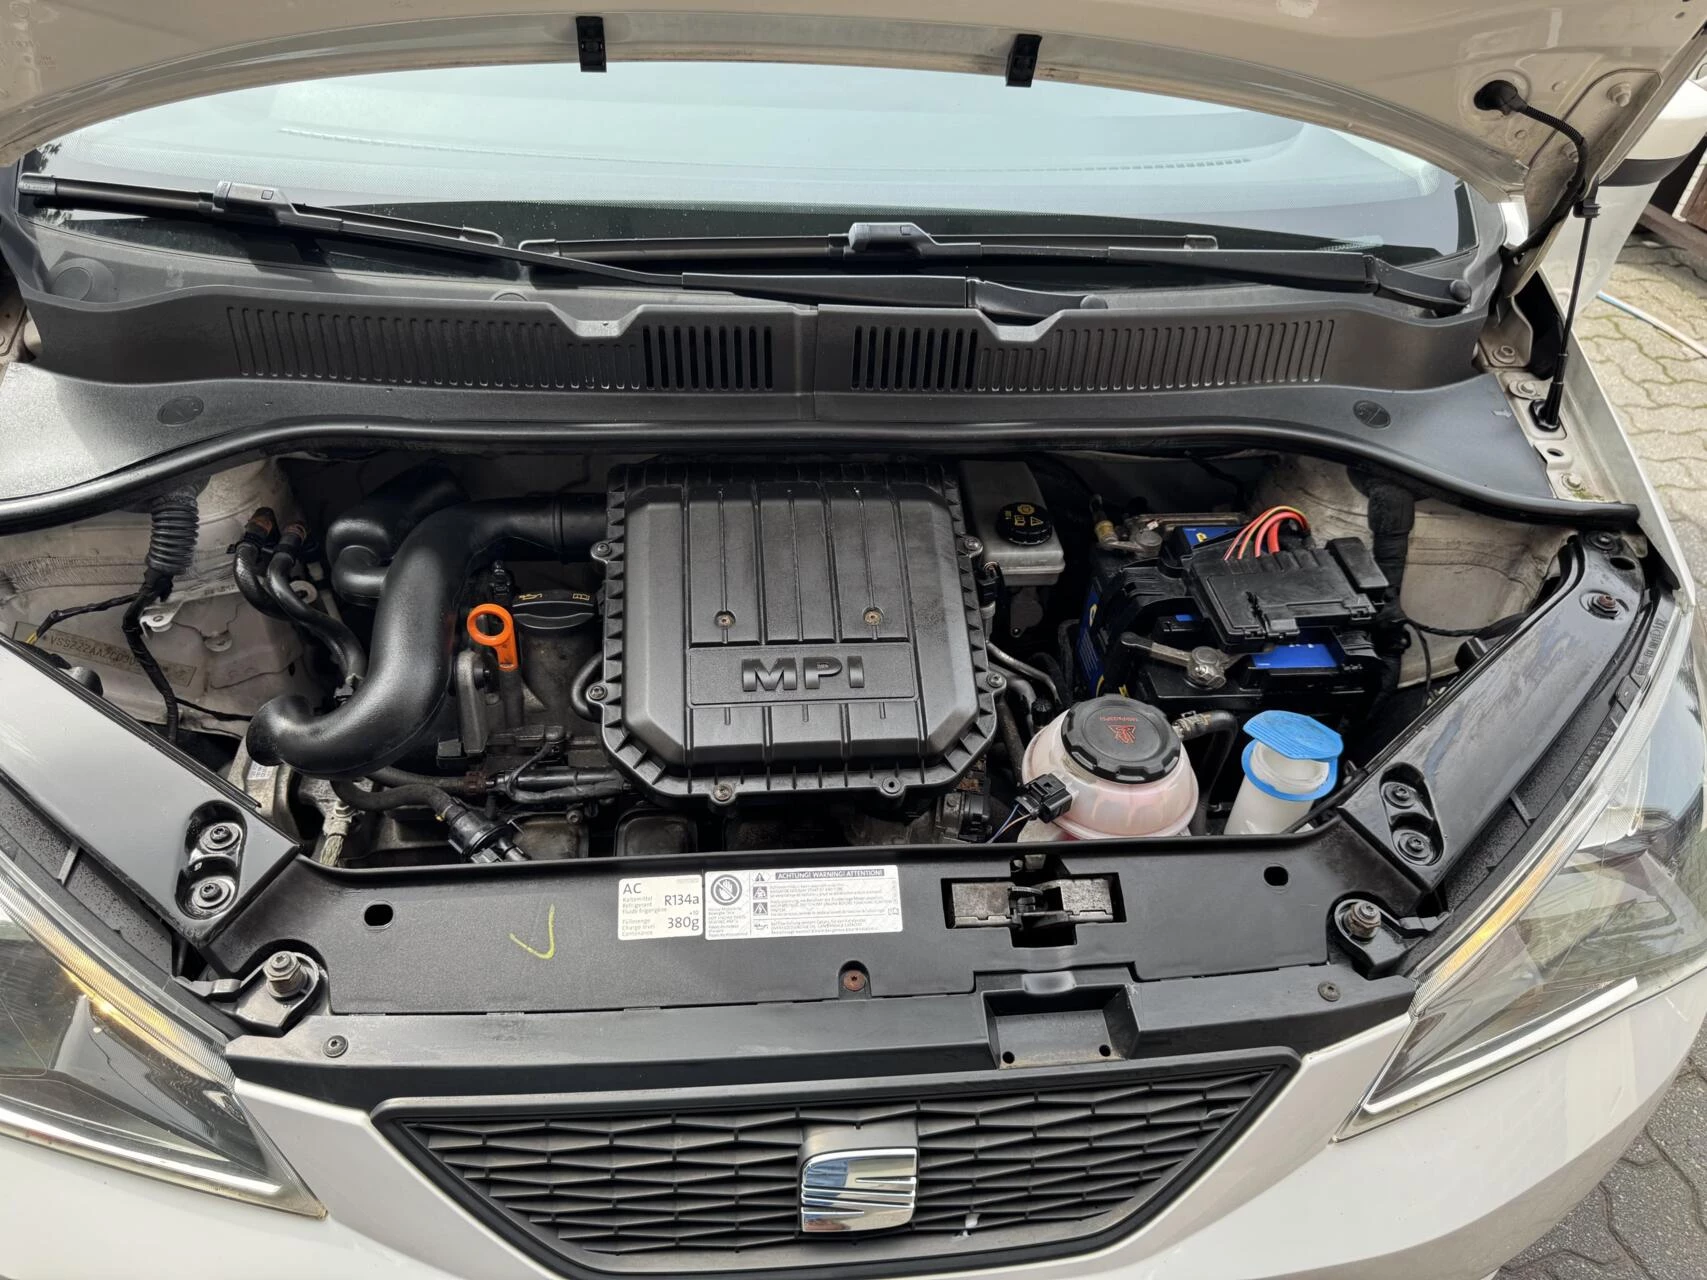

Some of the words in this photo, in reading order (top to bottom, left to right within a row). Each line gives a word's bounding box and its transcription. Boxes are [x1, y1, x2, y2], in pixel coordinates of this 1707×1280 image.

[741, 655, 865, 692] MPI
[812, 871, 846, 879] WARNING!
[847, 869, 883, 877] ATTENTION!
[623, 883, 642, 894] AC
[664, 894, 699, 906] R134a
[667, 917, 699, 931] 380g
